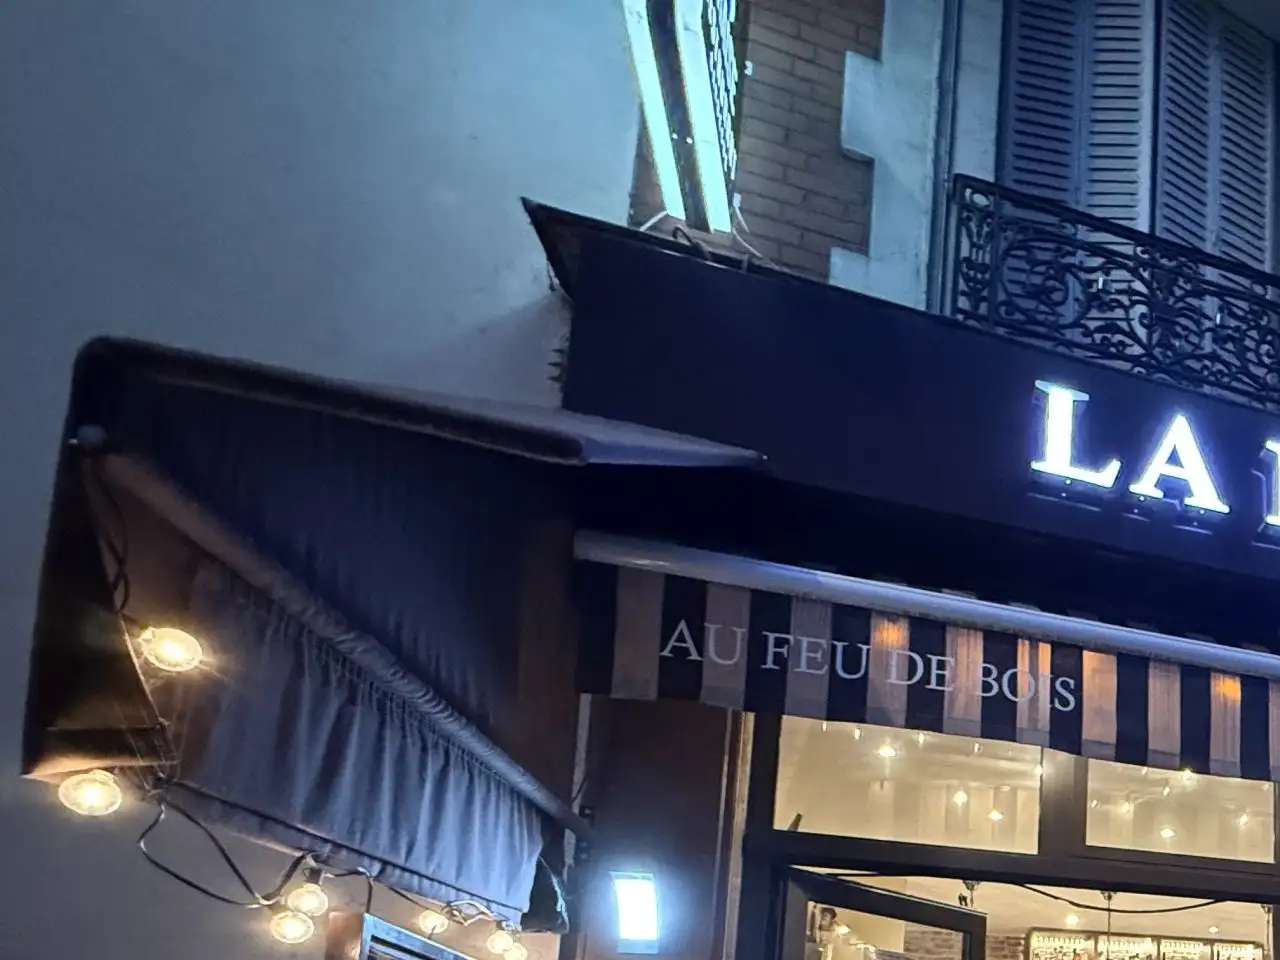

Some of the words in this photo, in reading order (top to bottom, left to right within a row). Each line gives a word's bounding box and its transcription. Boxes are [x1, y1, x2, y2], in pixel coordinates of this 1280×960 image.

[1031, 380, 1231, 514] LA
[660, 619, 747, 665] AU
[761, 631, 869, 679] FEU
[887, 648, 955, 691] DE
[976, 663, 1076, 711] BOIS
